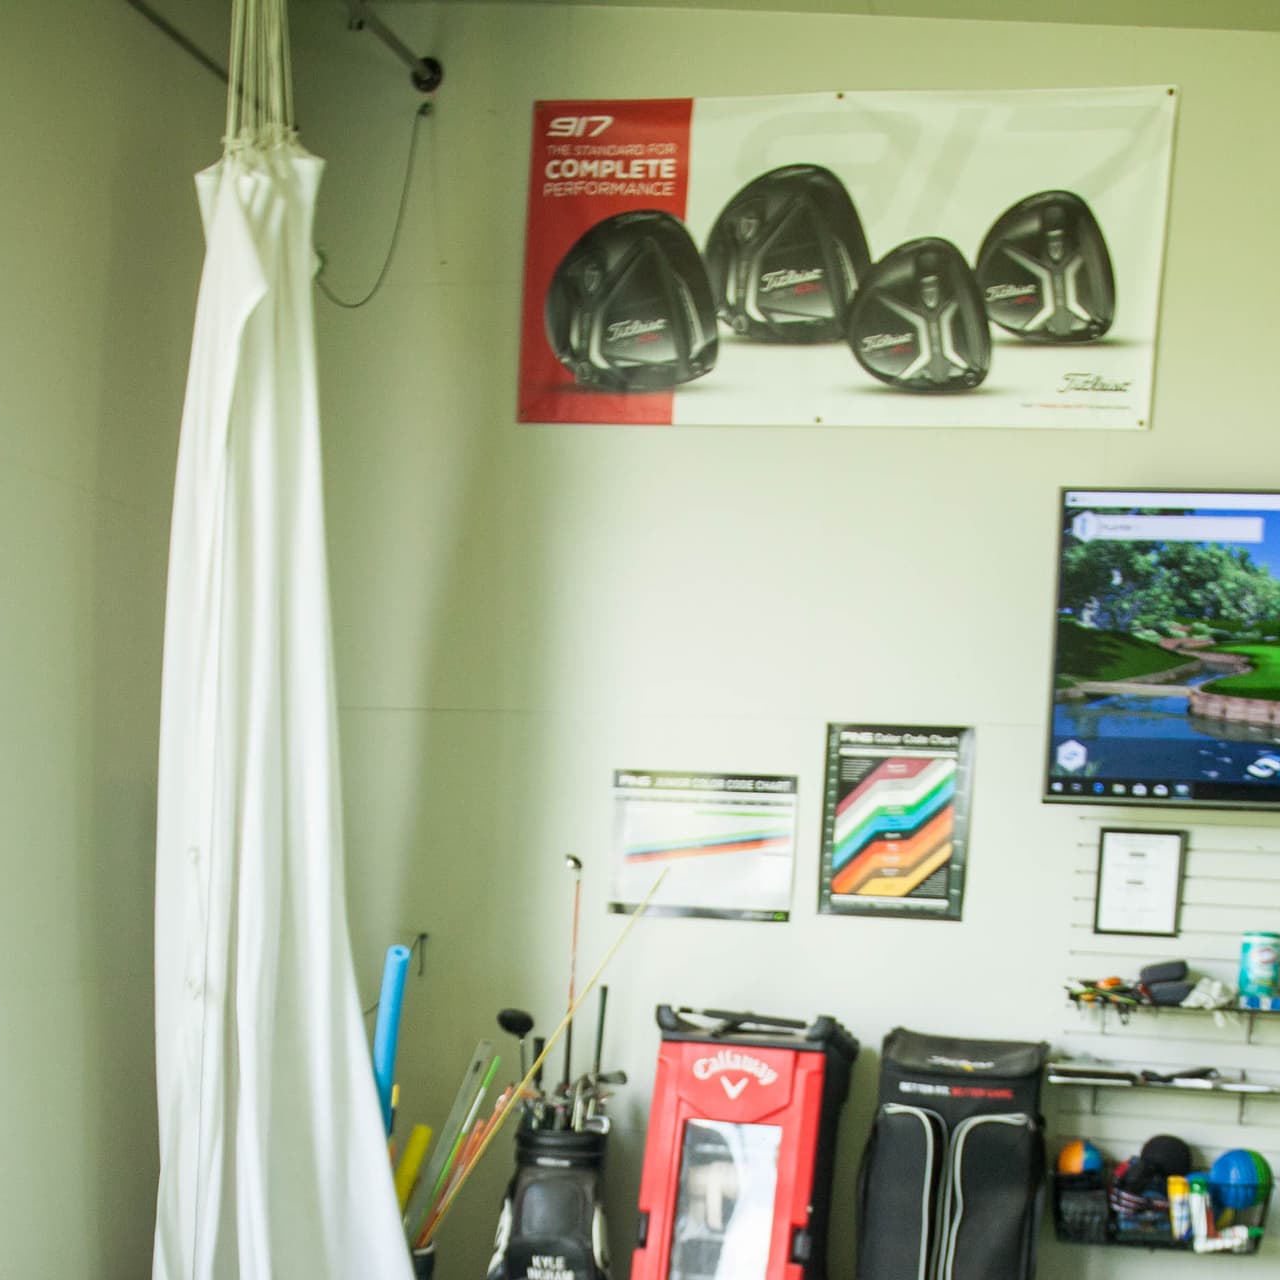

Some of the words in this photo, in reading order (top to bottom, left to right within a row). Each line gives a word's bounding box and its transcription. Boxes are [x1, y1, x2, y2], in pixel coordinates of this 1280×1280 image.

[546, 115, 614, 137] 917
[547, 144, 570, 156] THE
[574, 144, 645, 156] STANDARD
[647, 143, 677, 155] FOR
[545, 158, 677, 179] COMPLETE
[543, 181, 675, 197] PERFORMANCE
[693, 1049, 778, 1086] Callaway
[532, 1255, 566, 1269] KYLE
